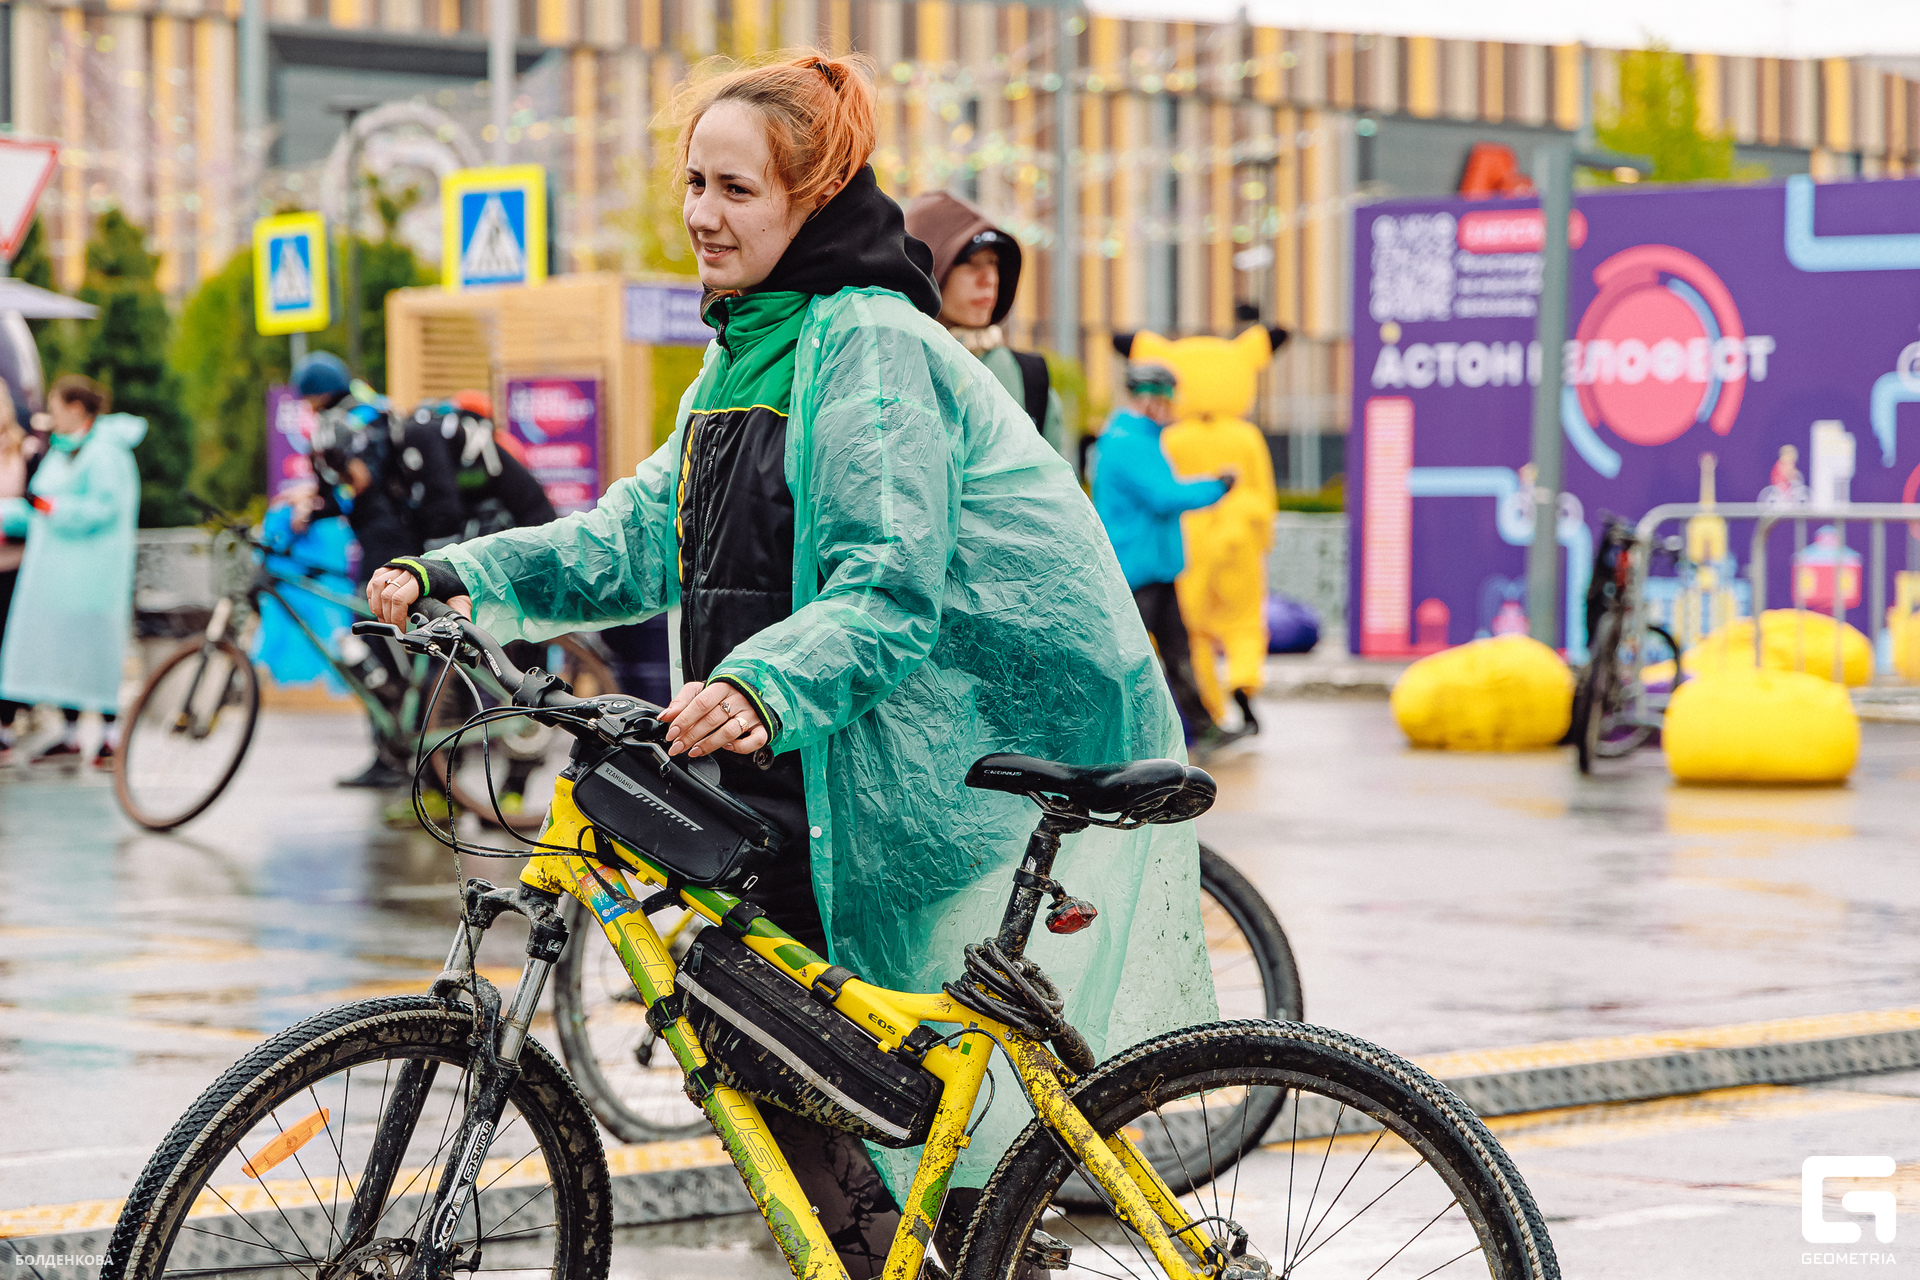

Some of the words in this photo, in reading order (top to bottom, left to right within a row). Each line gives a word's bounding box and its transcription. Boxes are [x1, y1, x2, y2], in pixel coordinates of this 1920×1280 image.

[1371, 342, 1524, 389] АСТОН
[604, 767, 634, 790] RZAHUAHU
[868, 1013, 897, 1035] EOS
[1125, 1203, 1144, 1225] BIKE
